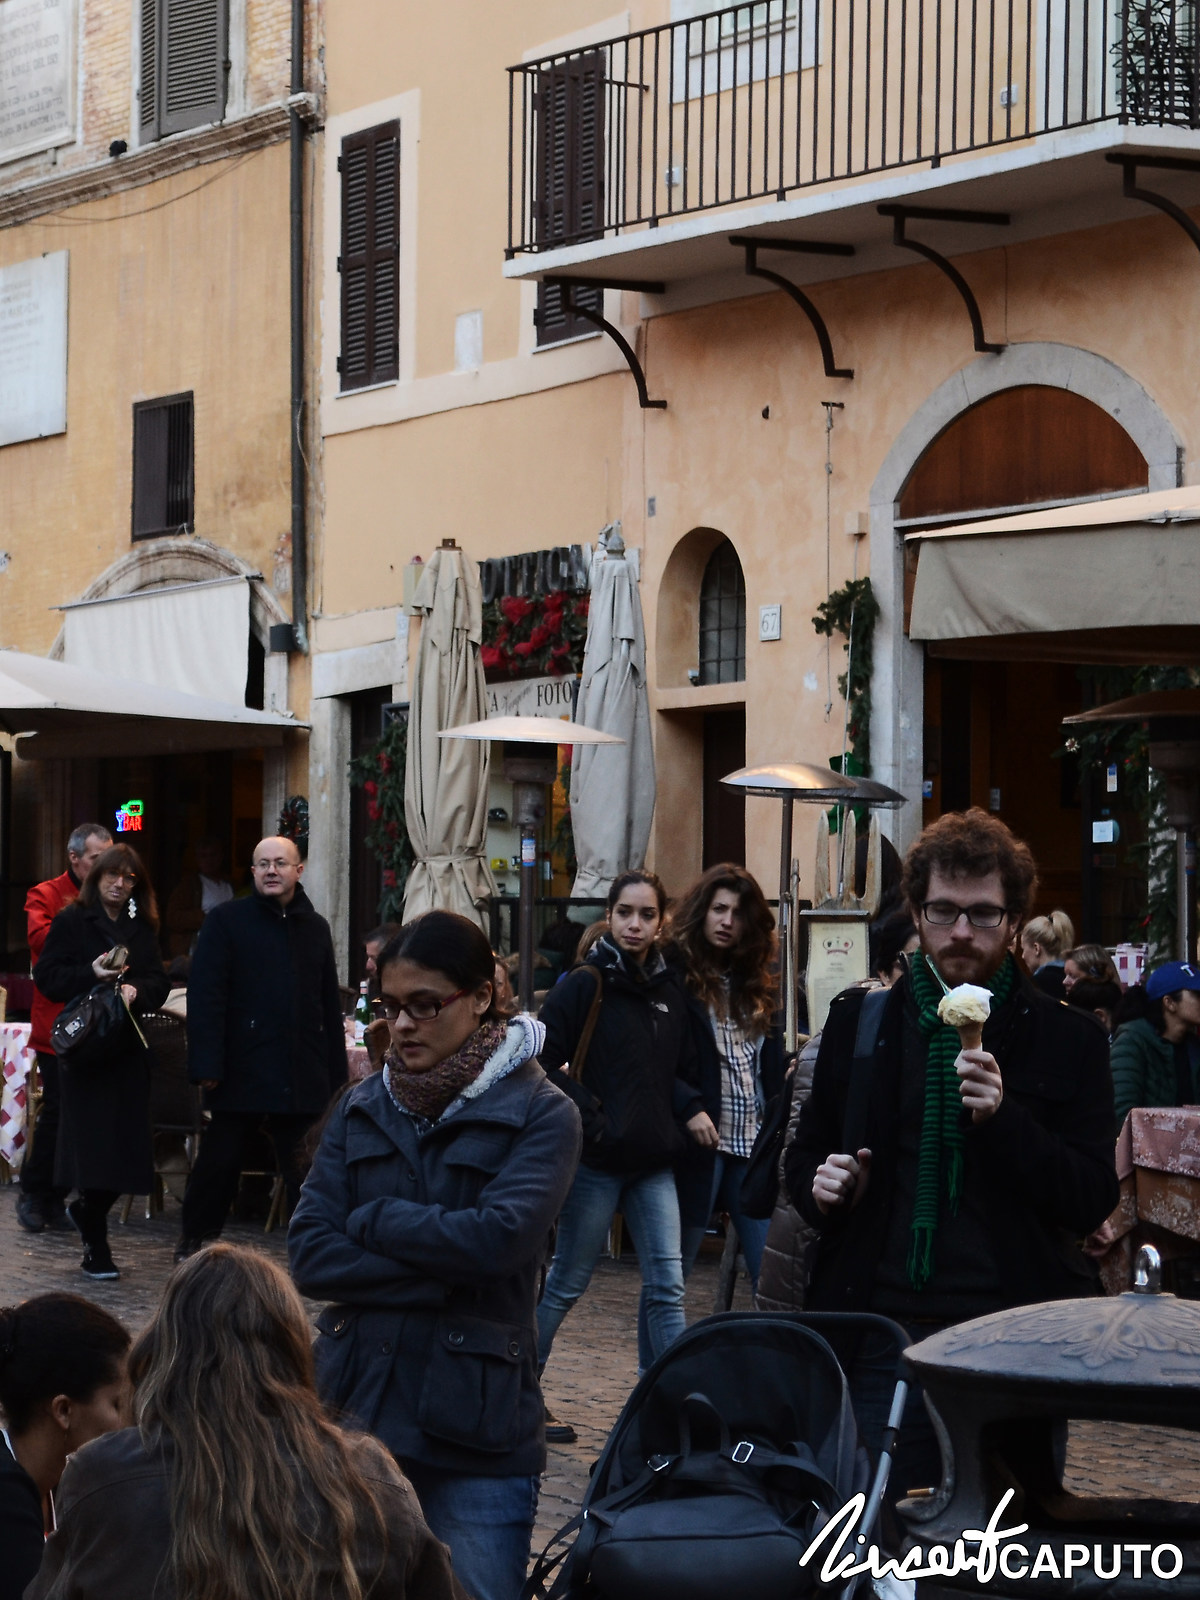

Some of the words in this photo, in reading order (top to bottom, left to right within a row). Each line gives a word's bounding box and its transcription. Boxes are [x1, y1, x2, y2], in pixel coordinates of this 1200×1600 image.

[761, 612, 777, 632] 67
[536, 681, 572, 707] FOTO
[123, 813, 142, 831] BAR
